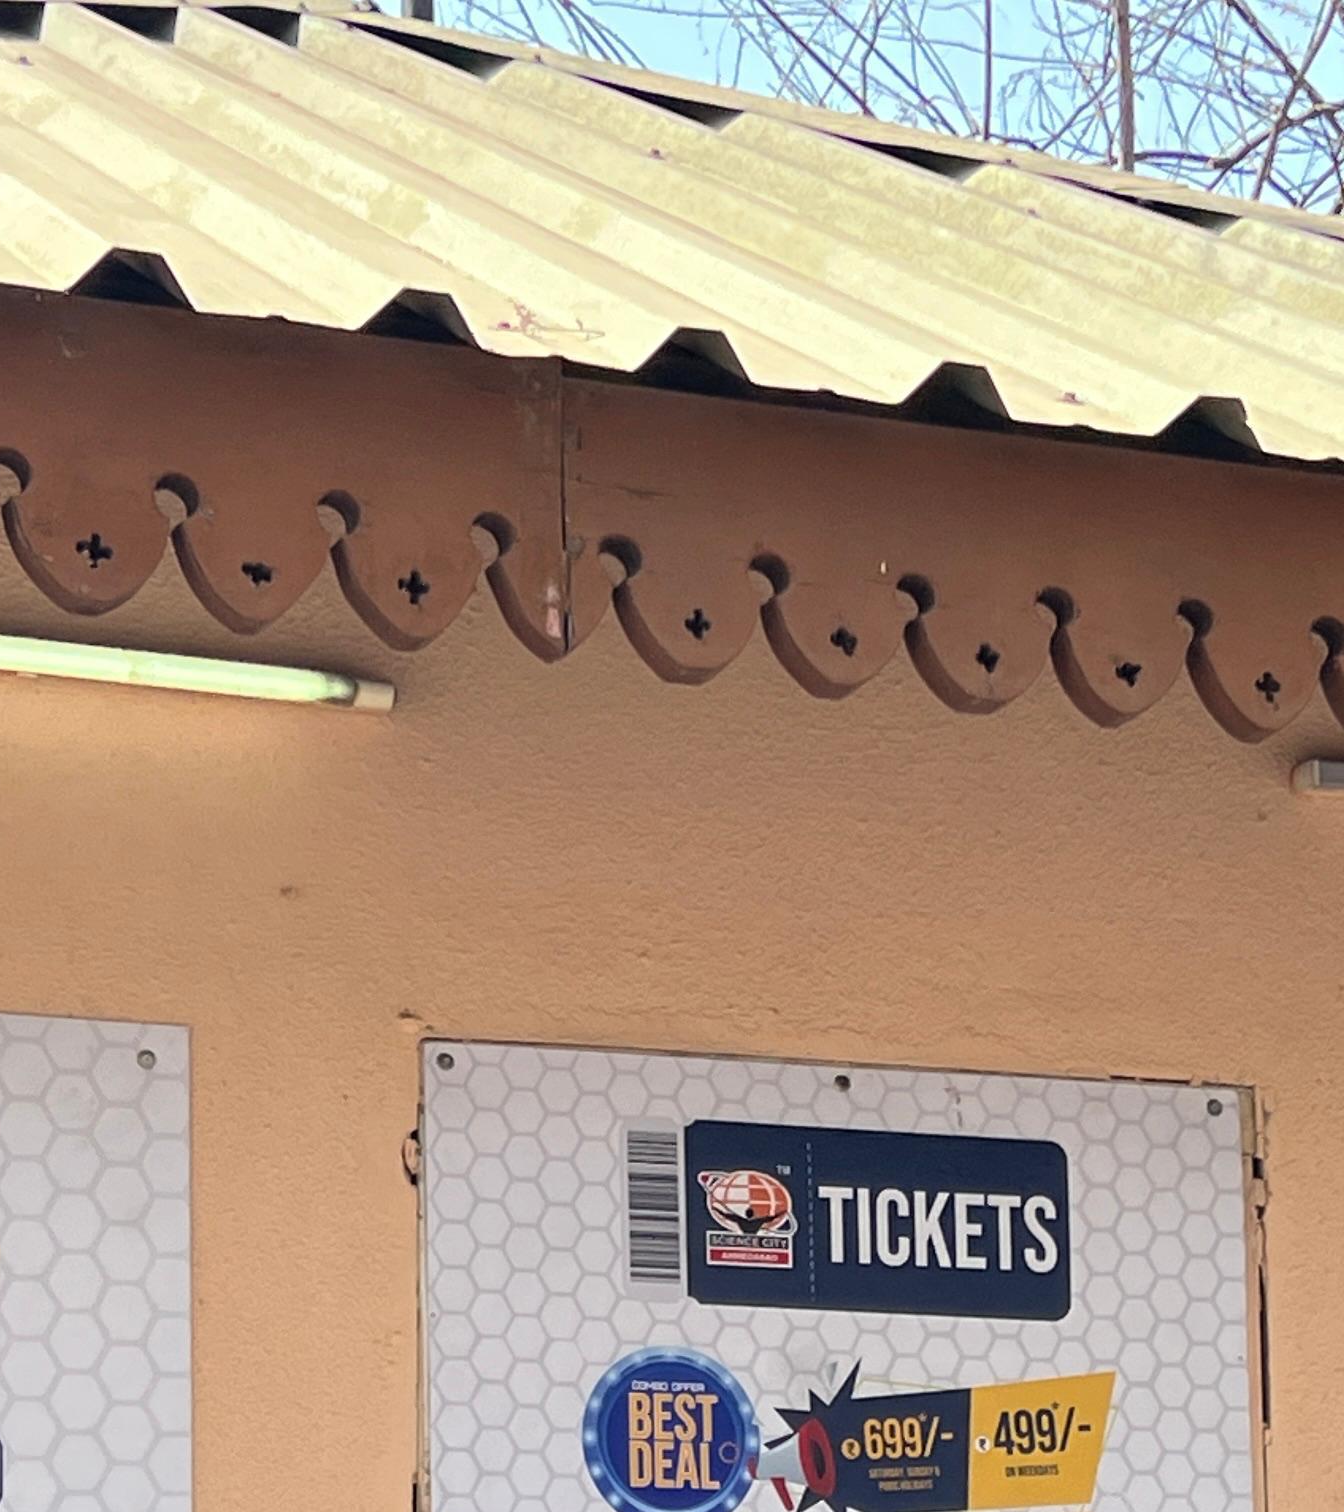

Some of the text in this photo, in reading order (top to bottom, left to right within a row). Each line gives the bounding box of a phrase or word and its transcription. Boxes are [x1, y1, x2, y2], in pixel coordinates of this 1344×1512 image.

[710, 1234, 788, 1249] SCIENCE CITY
[818, 1185, 1058, 1274] TICKETS
[628, 1393, 719, 1442] BEST
[629, 1440, 721, 1490] DEAL
